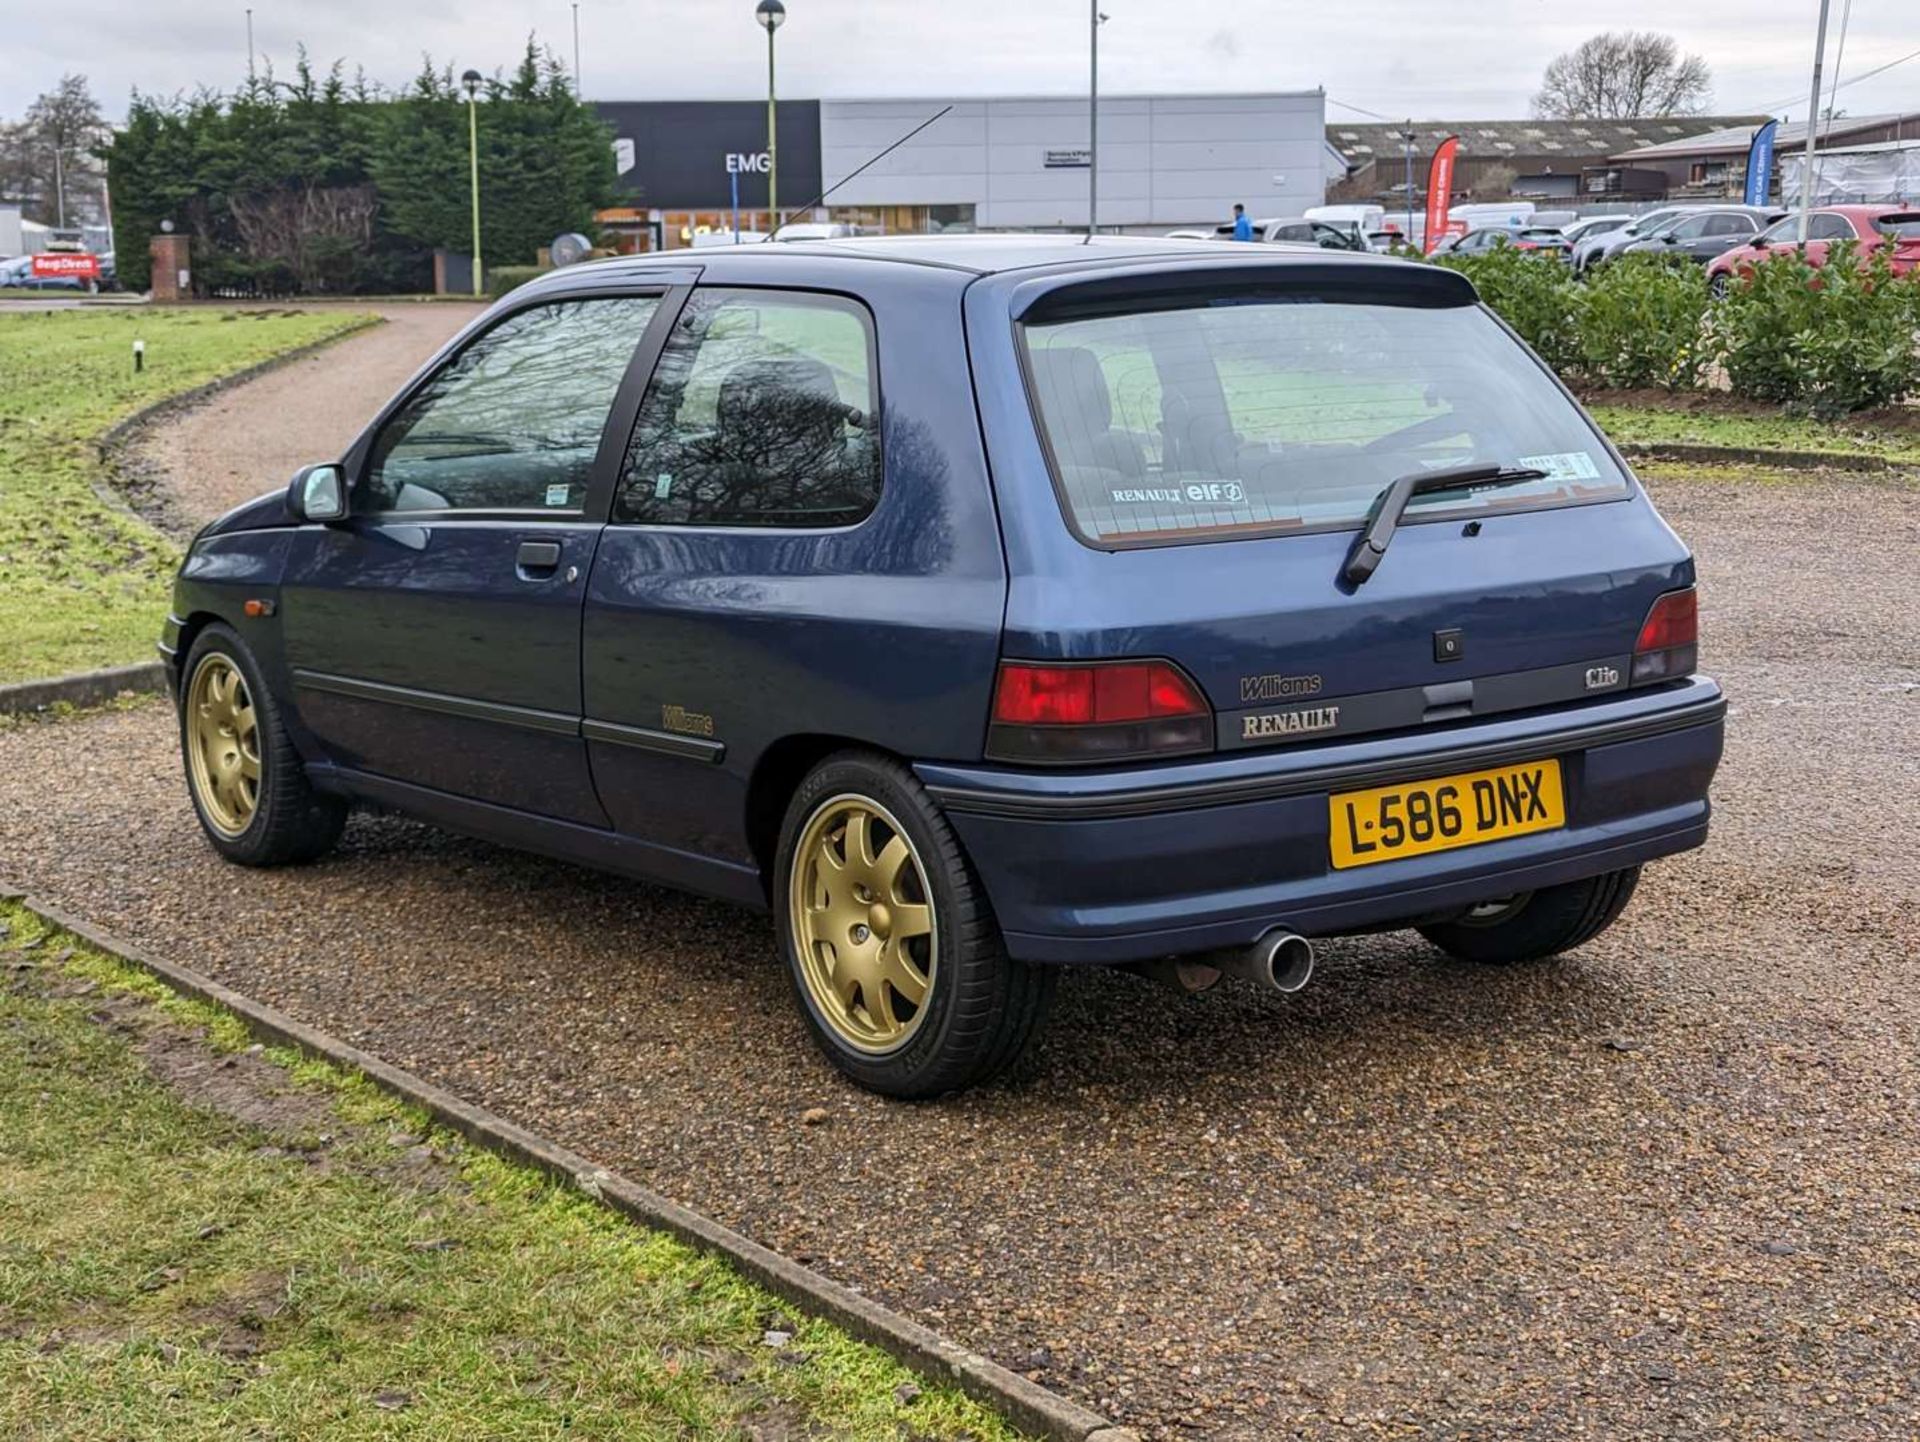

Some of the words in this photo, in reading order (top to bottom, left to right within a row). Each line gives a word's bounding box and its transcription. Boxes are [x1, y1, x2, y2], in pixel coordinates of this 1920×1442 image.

[726, 153, 771, 173] EMG
[1111, 488, 1182, 503] RENAULT
[1187, 484, 1221, 501] elf
[1240, 672, 1323, 701] Williams
[1584, 666, 1619, 689] Clio
[662, 703, 714, 736] Williams
[1241, 706, 1340, 738] RENAULT
[1346, 786, 1464, 855] L586
[1472, 769, 1549, 832] DNX
